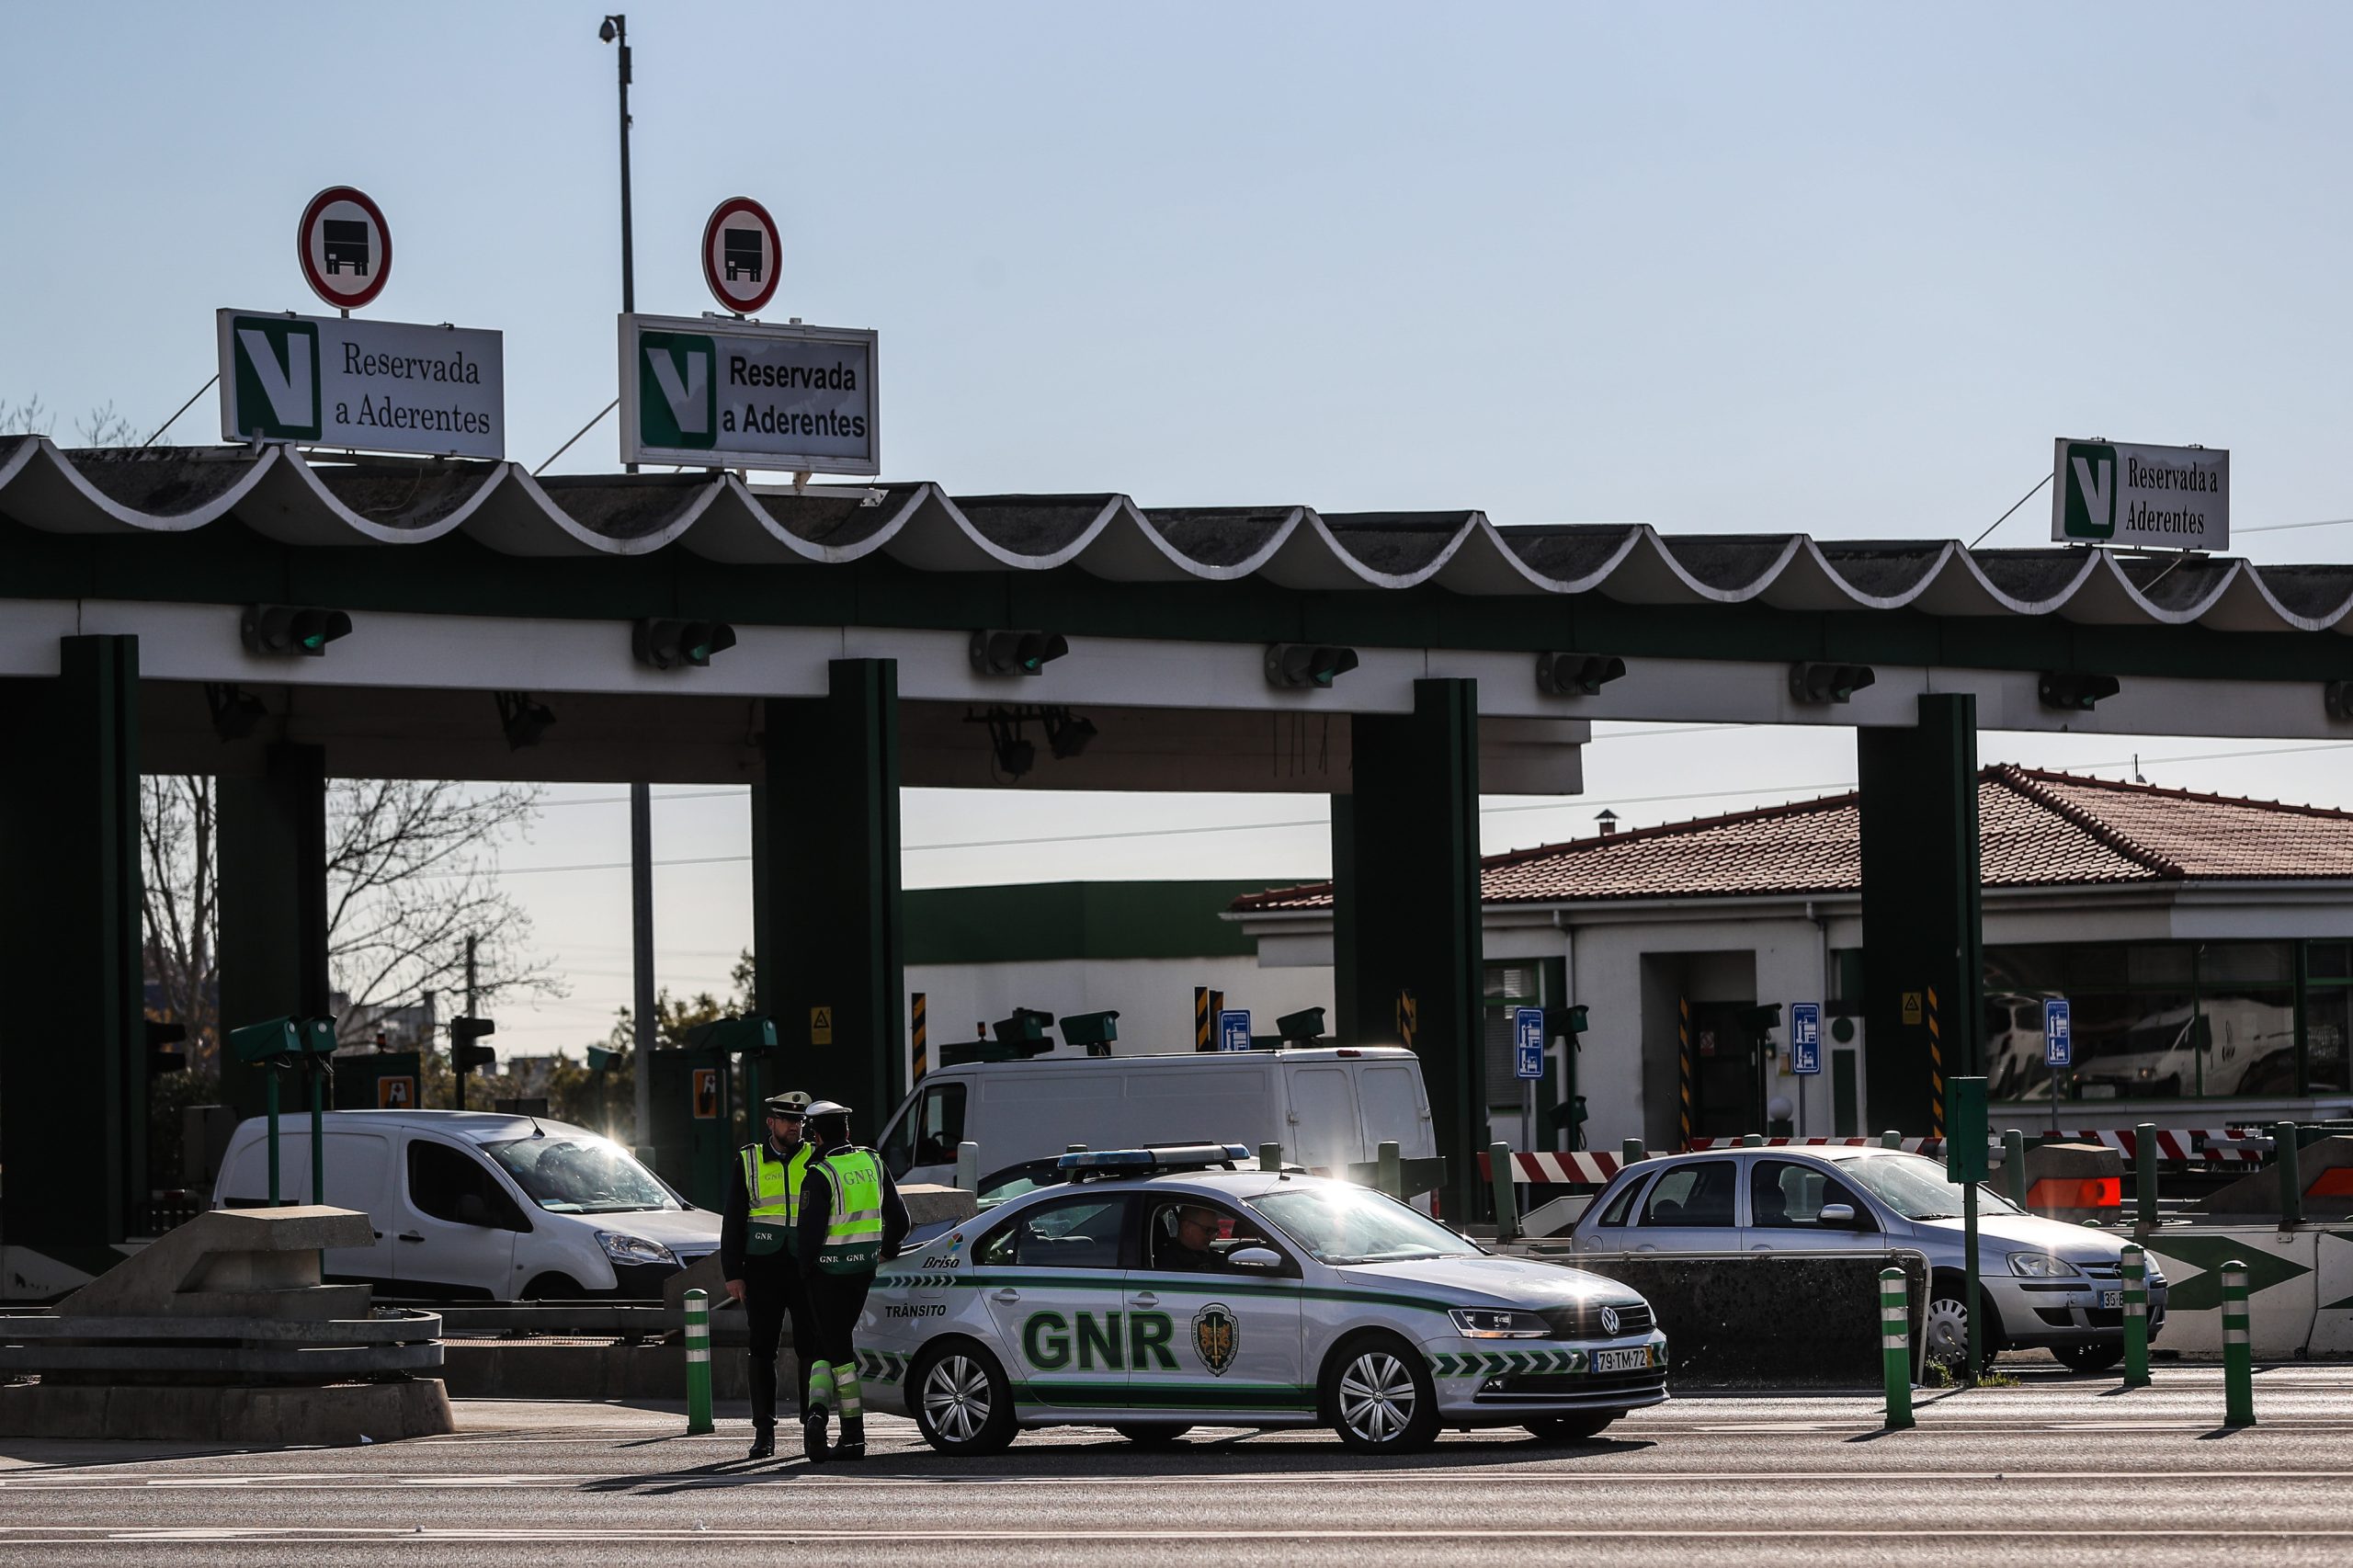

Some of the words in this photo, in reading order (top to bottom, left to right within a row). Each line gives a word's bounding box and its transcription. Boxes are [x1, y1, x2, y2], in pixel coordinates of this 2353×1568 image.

[342, 342, 481, 384] Reservada
[730, 356, 857, 391] Reservada
[335, 403, 350, 426] a
[357, 393, 490, 434] Aderentes
[722, 409, 735, 432] a
[743, 404, 866, 437] Aderentes
[2128, 458, 2206, 492] Reservada
[2210, 472, 2218, 493] a
[2126, 500, 2204, 534] Aderentes
[843, 1168, 877, 1186] GNR
[755, 1233, 773, 1241] GNR
[847, 1254, 865, 1262] GNR
[885, 1303, 946, 1318] TRÂNSITO
[1022, 1310, 1181, 1371] GNR
